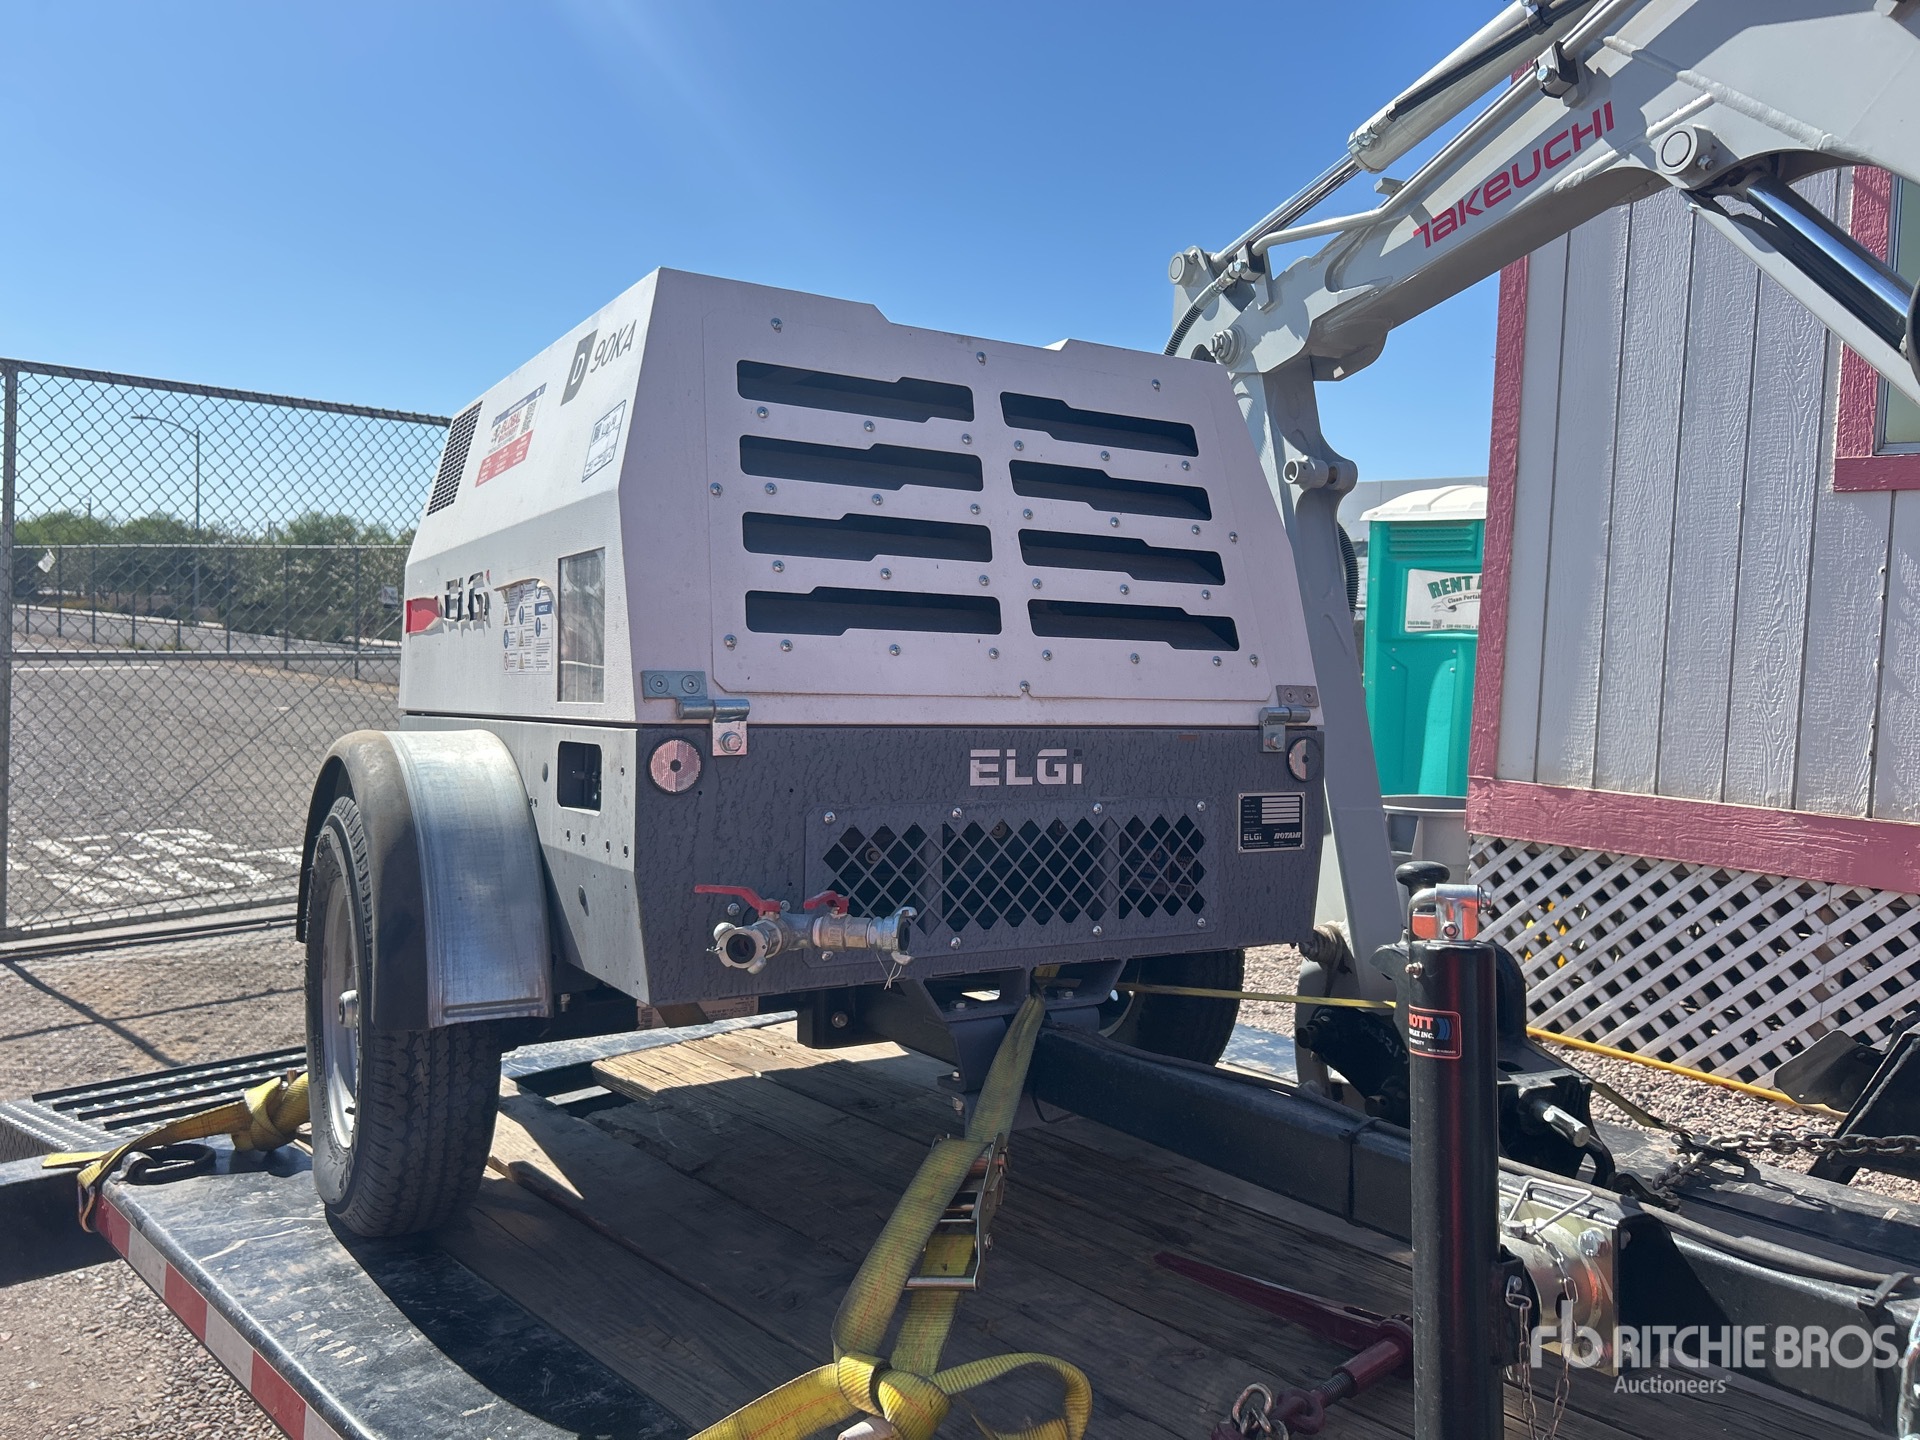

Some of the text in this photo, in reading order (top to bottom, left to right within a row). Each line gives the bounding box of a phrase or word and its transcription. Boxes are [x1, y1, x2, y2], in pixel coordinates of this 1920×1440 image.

[1413, 100, 1614, 248] TAKEUCHI
[590, 319, 637, 373] 90KA
[1427, 575, 1473, 599] RENT
[1447, 596, 1463, 604] Clean
[1420, 1031, 1435, 1040] INC.
